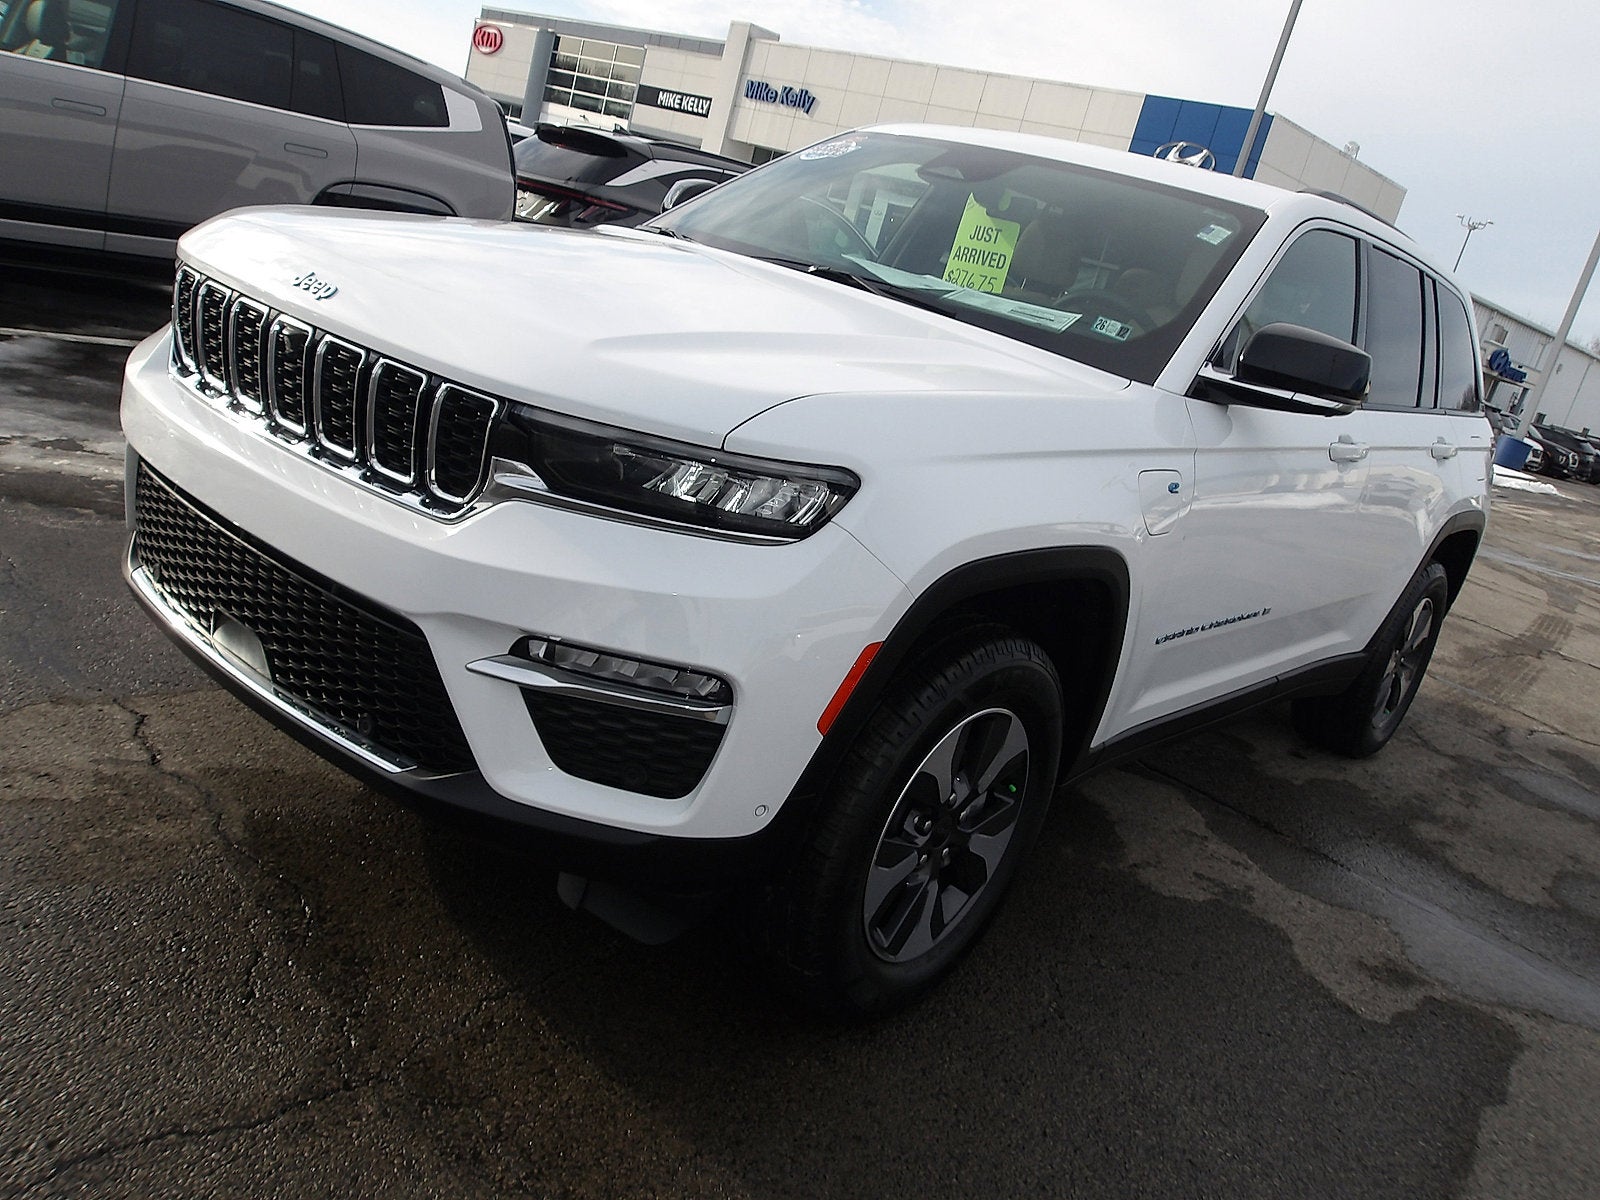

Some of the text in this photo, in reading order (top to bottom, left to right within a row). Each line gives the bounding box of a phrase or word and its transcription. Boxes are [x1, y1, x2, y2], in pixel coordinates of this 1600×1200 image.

[475, 29, 499, 49] KIA
[657, 90, 710, 115] MIKE KELLY
[744, 79, 816, 114] Mike Kelly
[969, 225, 1002, 244] JUST
[953, 245, 1007, 270] ARRIVED
[293, 272, 339, 301] Jeep
